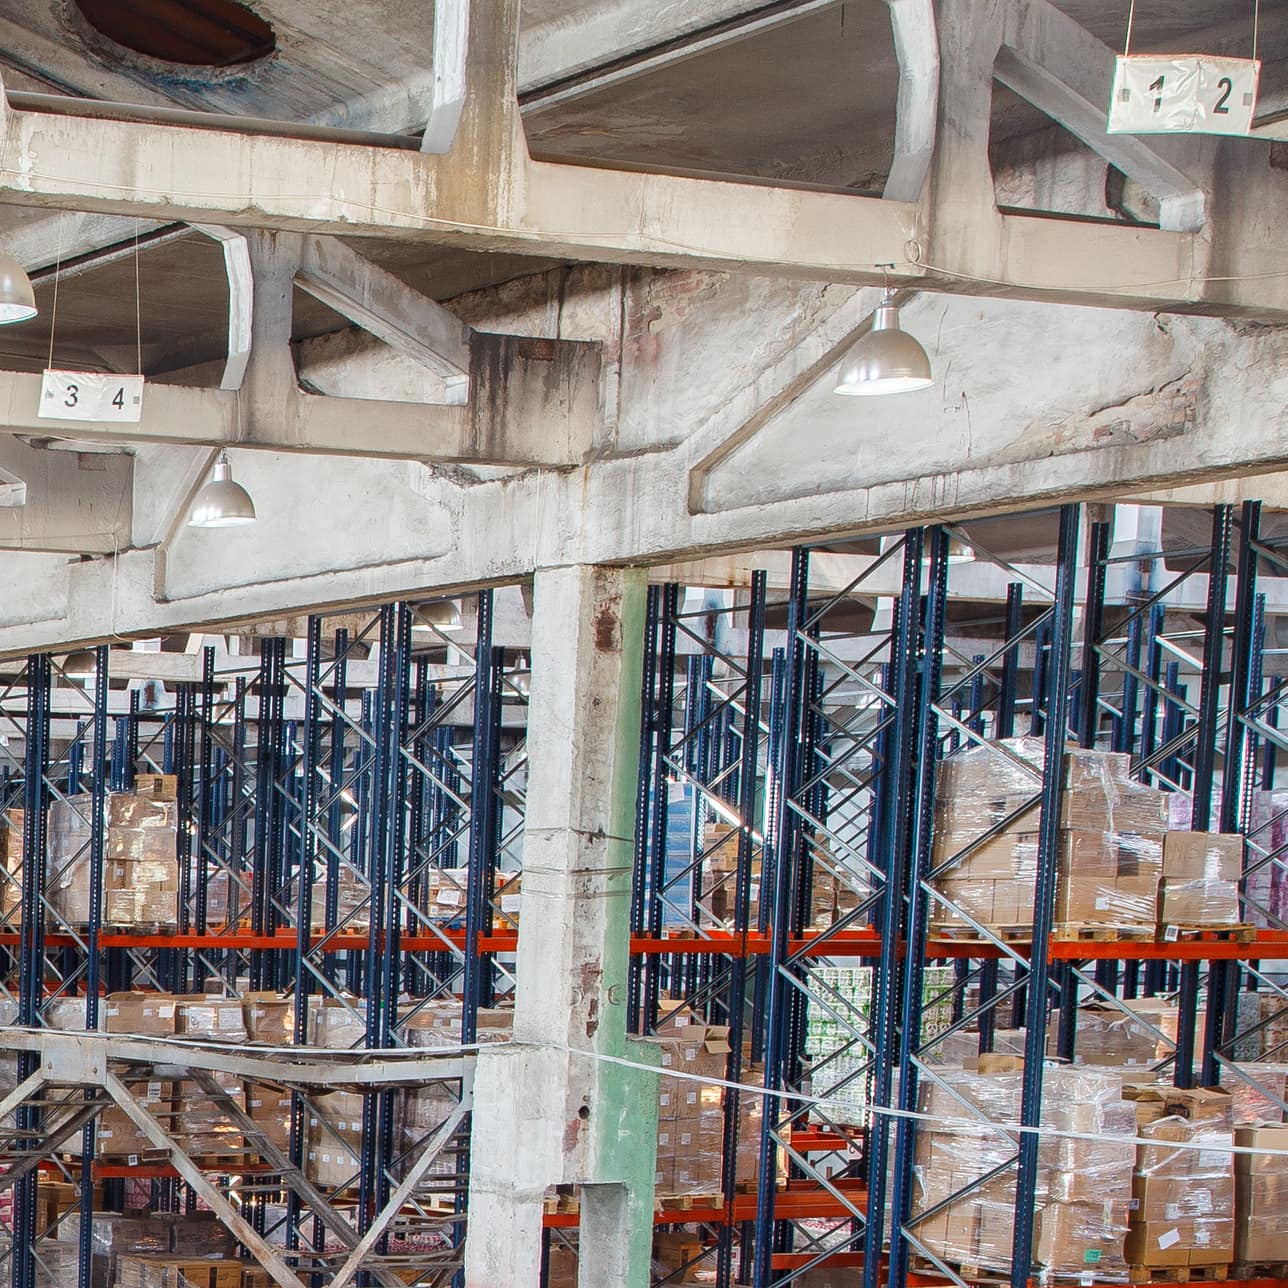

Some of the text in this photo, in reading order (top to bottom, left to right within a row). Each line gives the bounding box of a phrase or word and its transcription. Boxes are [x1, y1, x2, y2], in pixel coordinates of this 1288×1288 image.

[1149, 75, 1232, 114] 1 2
[64, 385, 124, 410] 3 4
